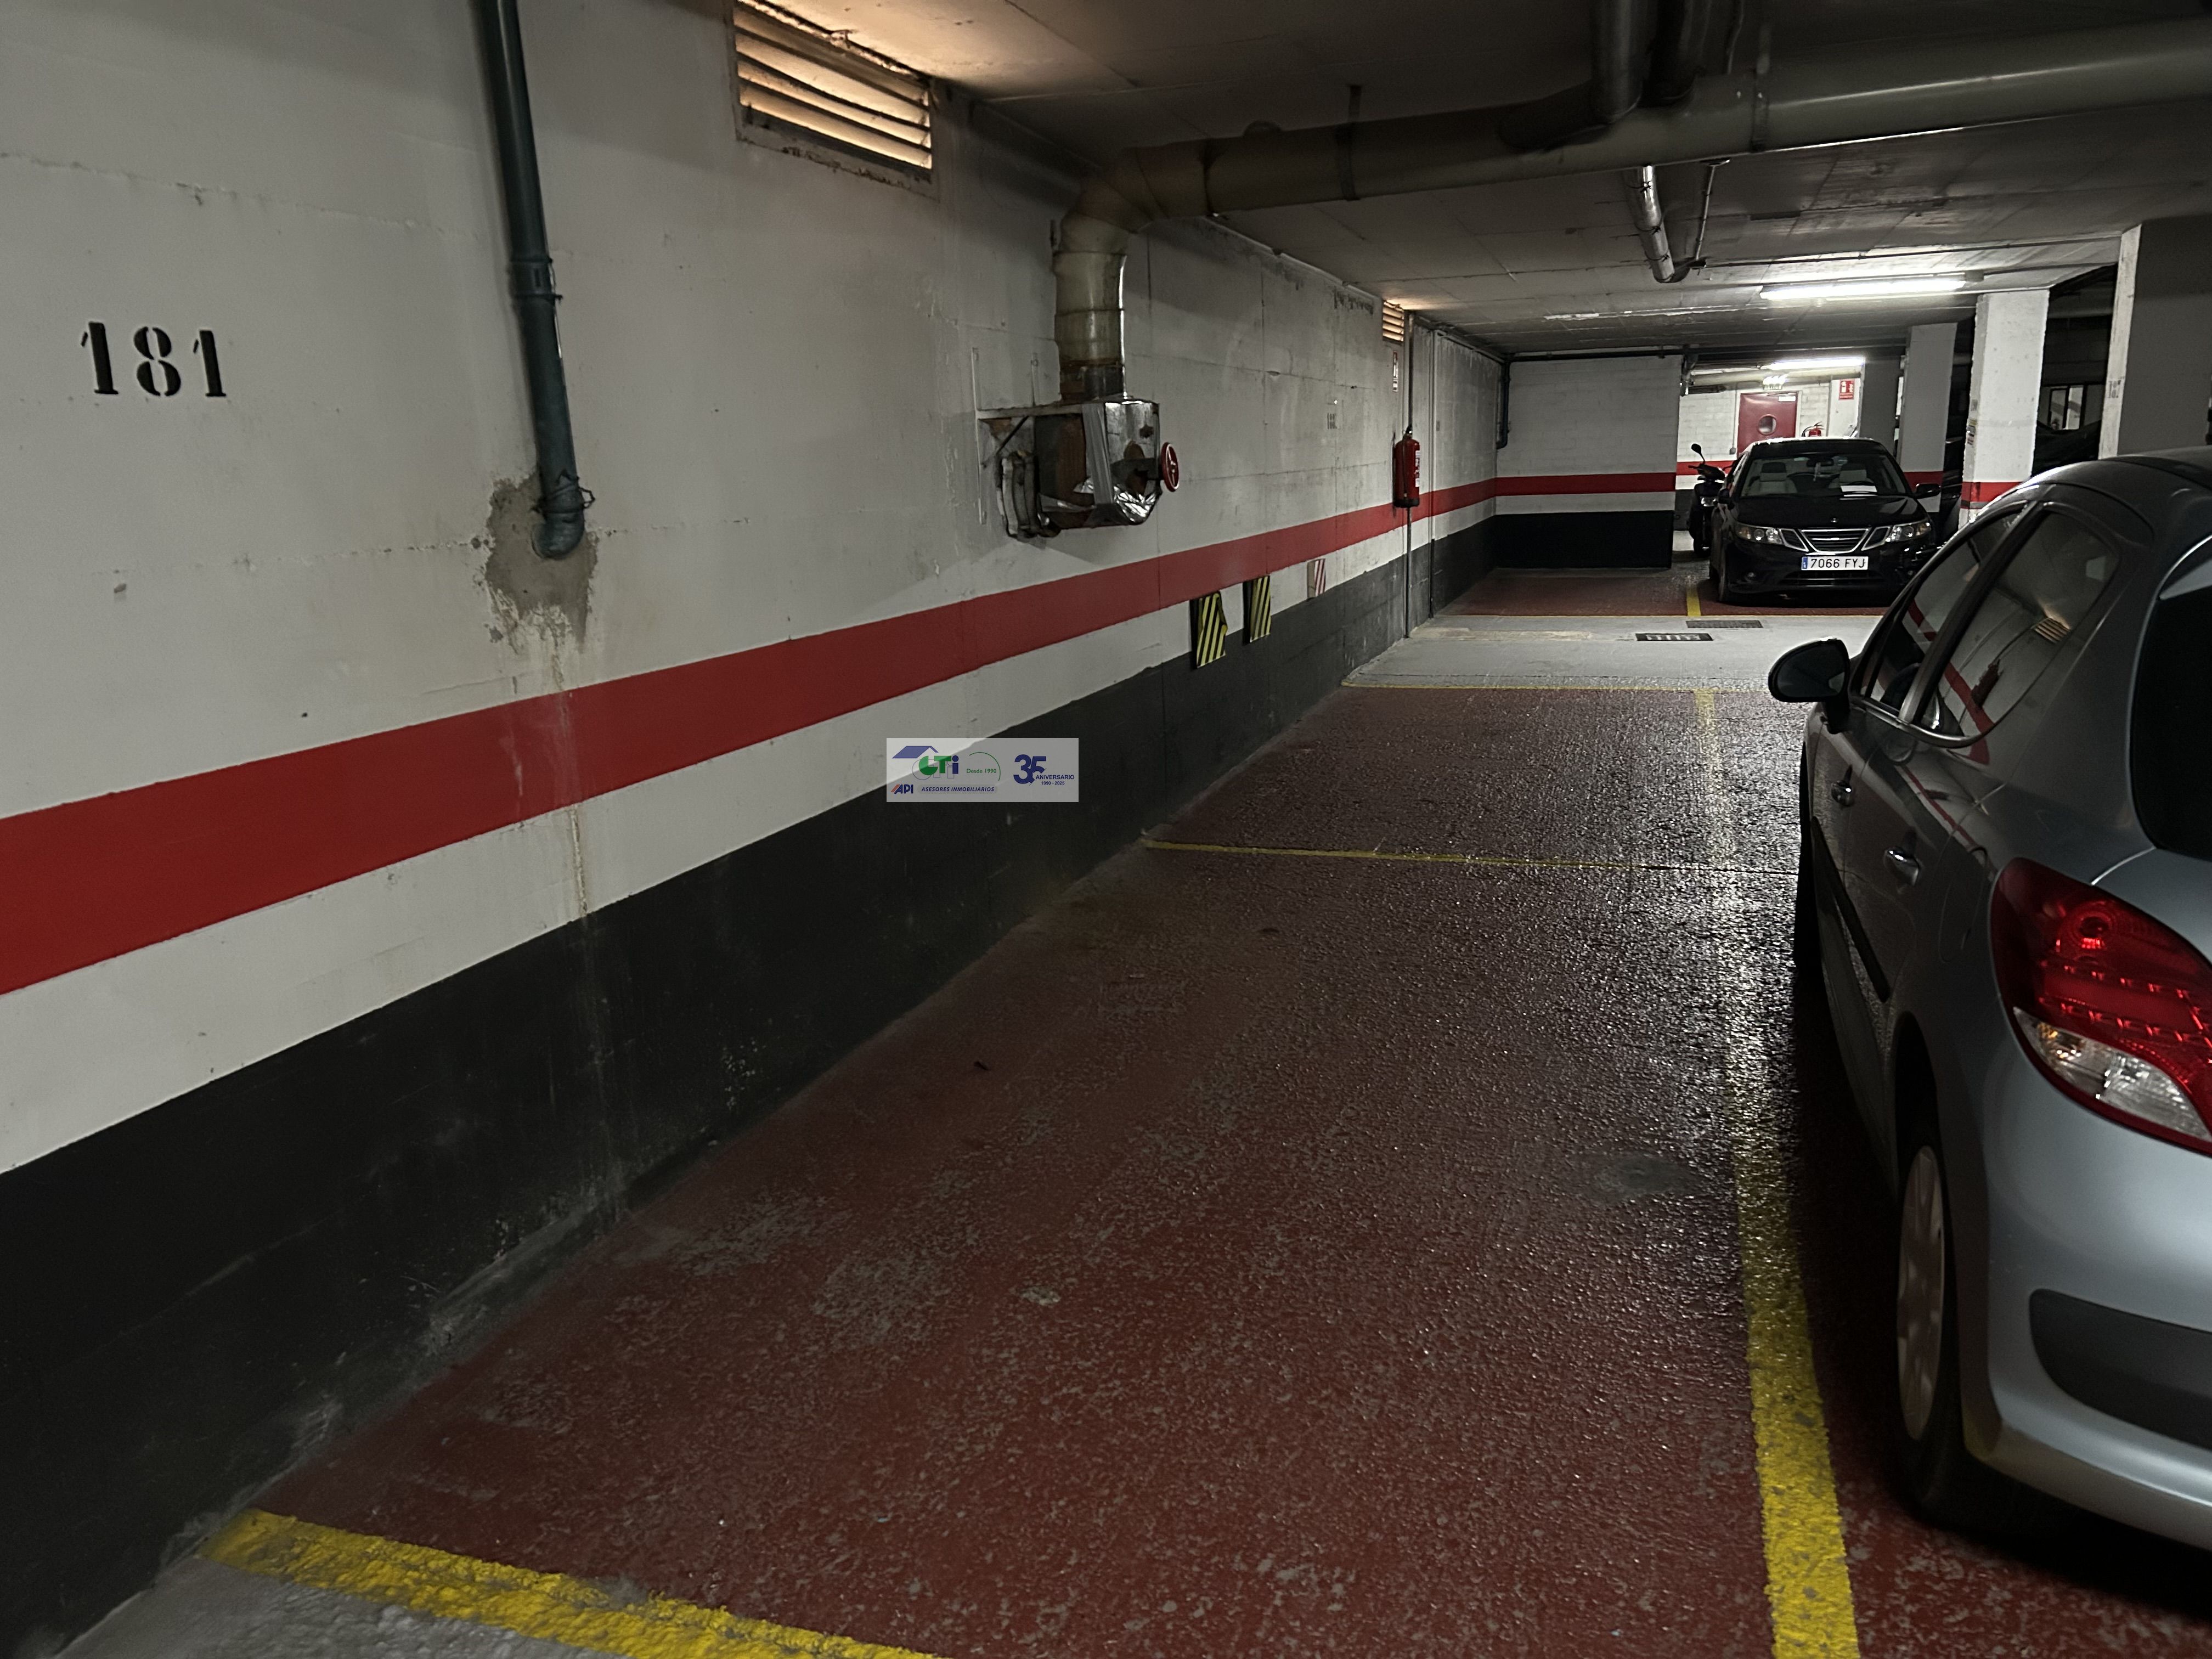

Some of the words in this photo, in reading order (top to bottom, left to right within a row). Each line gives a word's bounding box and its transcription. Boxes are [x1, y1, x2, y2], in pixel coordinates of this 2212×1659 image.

[80, 321, 227, 397] 181
[1810, 558, 1840, 568] 7066
[1844, 558, 1866, 568] FYJ
